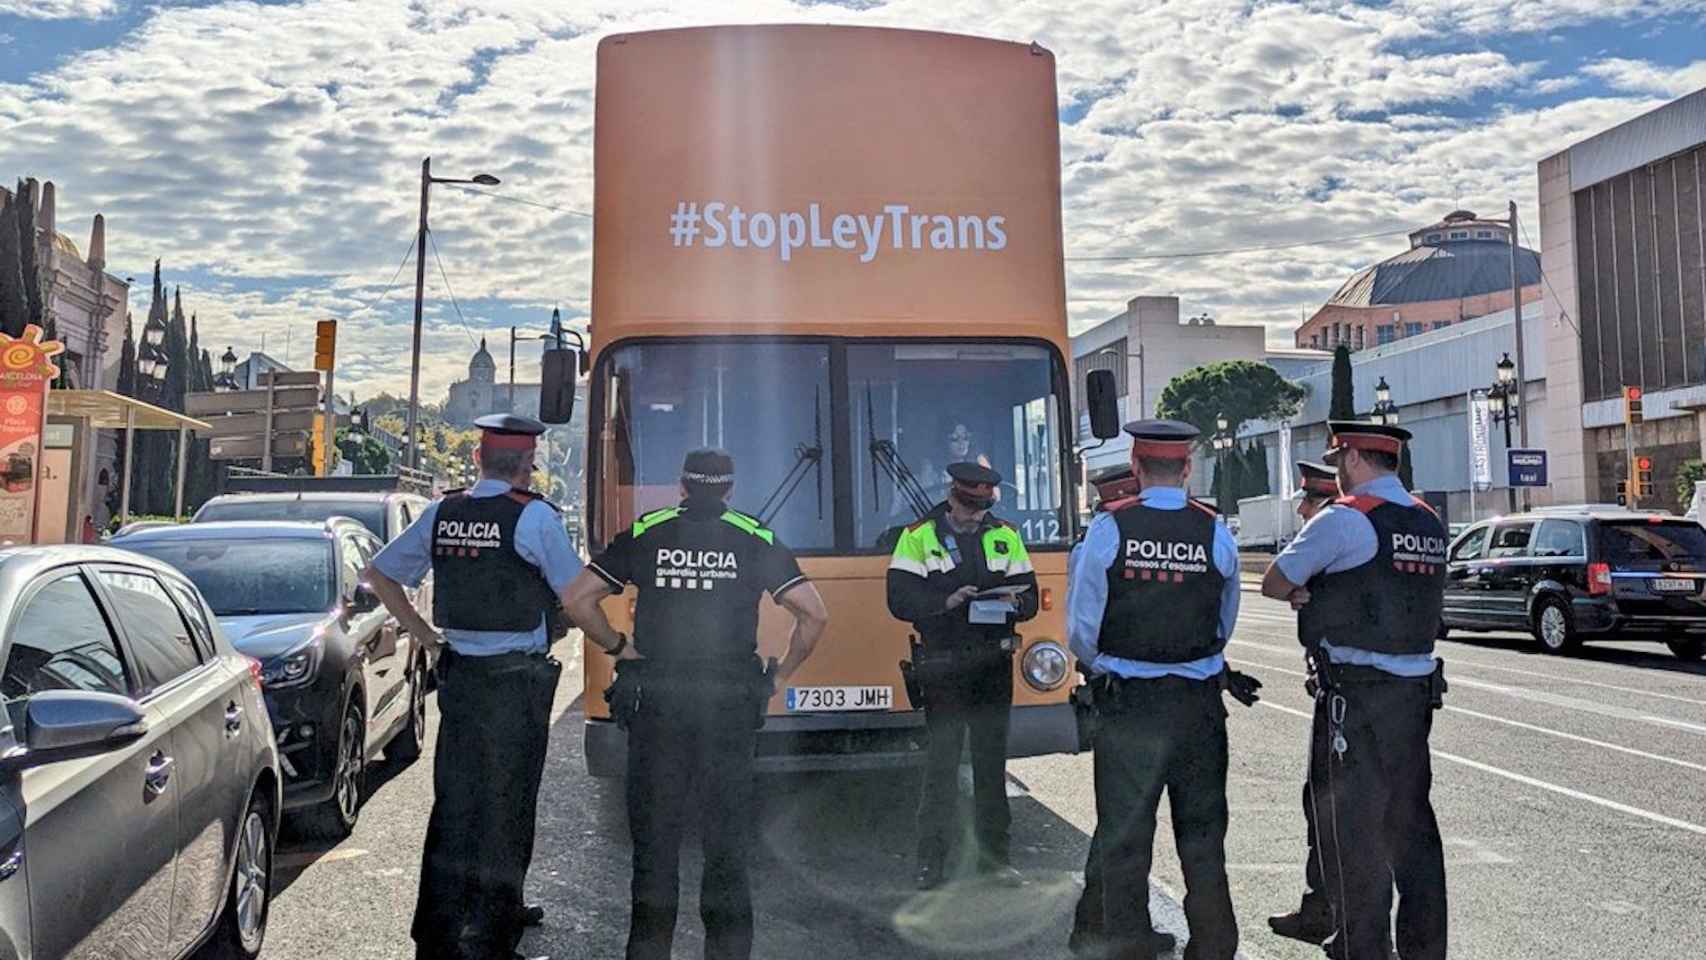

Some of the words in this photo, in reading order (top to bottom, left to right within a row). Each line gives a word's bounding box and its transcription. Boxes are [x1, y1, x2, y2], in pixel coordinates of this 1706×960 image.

[669, 201, 1008, 263] #StopLeyTrans
[1520, 473, 1537, 482] taxi
[437, 520, 501, 539] POLICIA
[1022, 519, 1060, 543] 112
[1126, 538, 1207, 562] POLICIA
[1392, 533, 1446, 555] POLICIA
[656, 548, 737, 569] POLICIA
[1125, 559, 1159, 569] mossos
[699, 569, 737, 579] urbana
[799, 689, 846, 708] 7303
[854, 687, 889, 707] JMH
